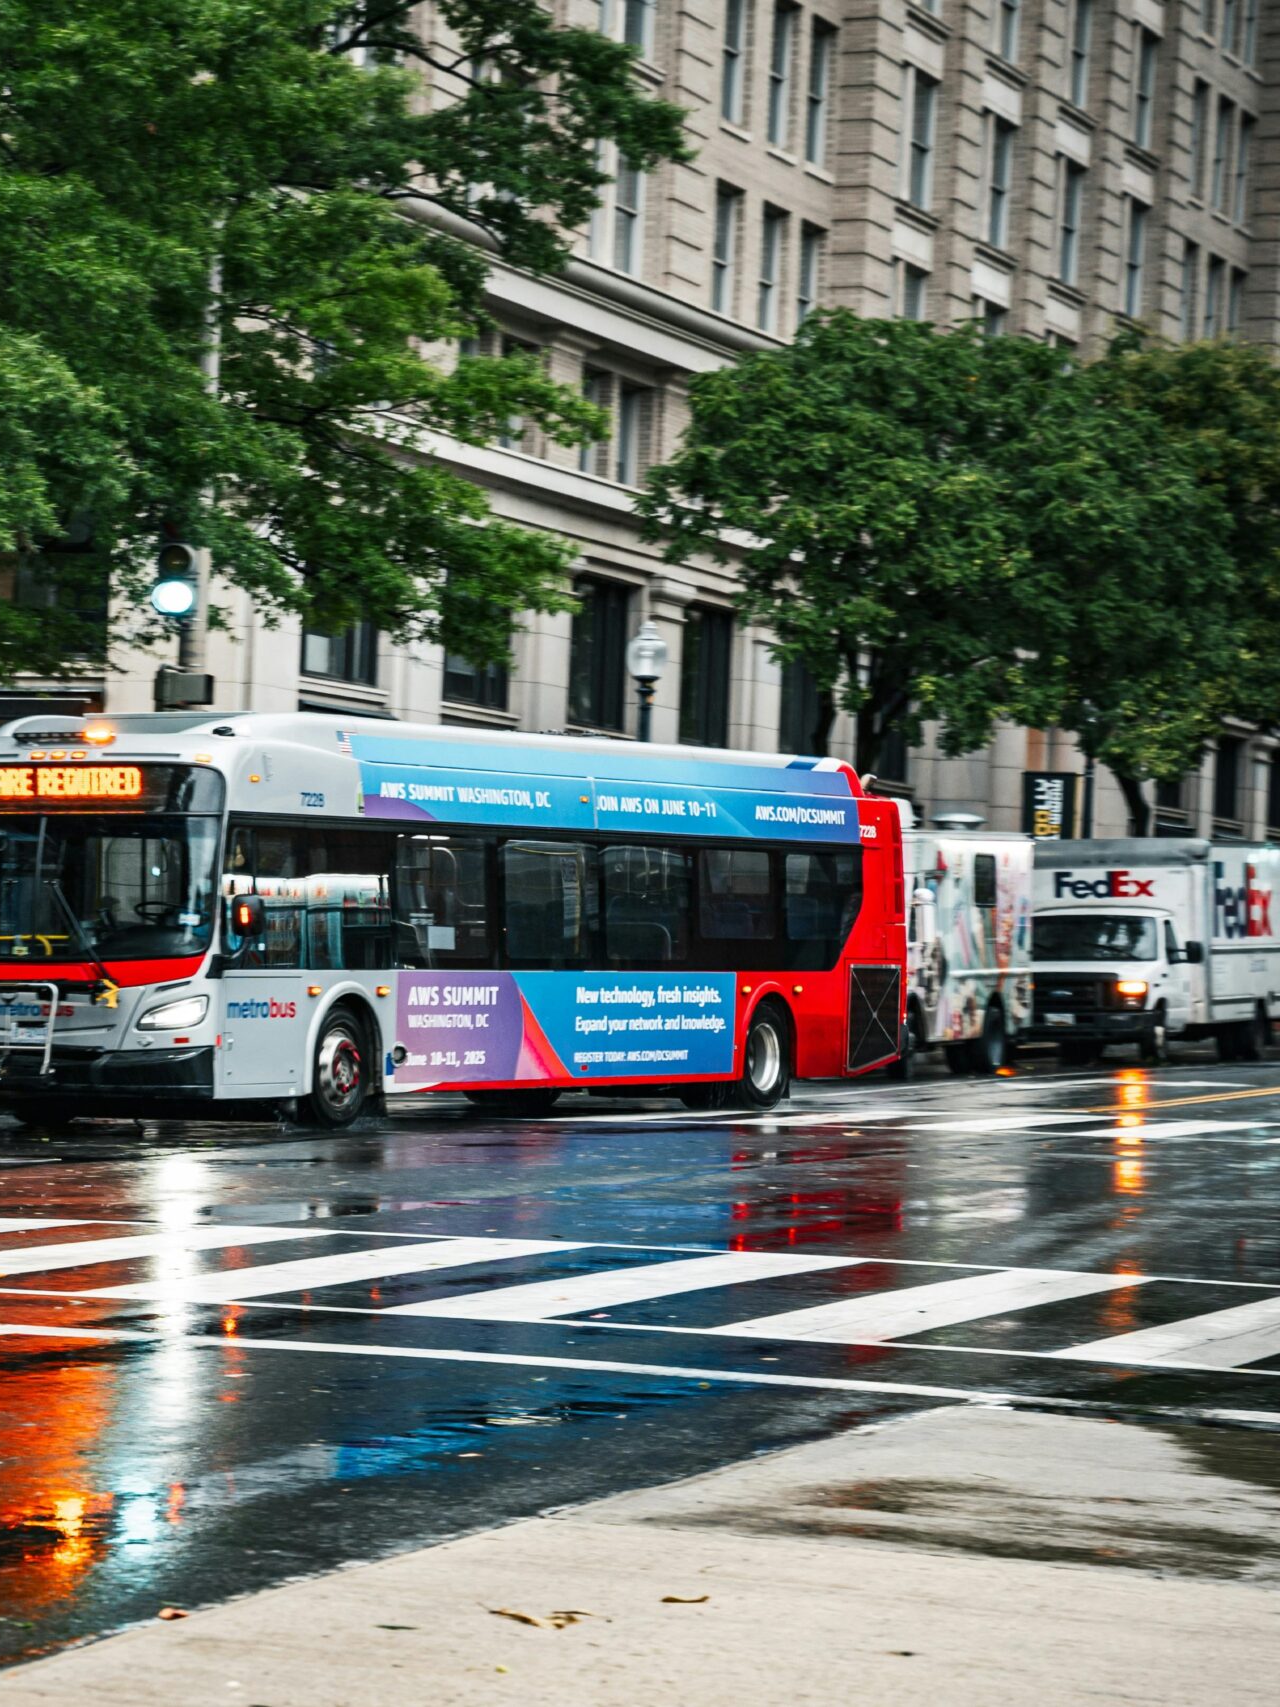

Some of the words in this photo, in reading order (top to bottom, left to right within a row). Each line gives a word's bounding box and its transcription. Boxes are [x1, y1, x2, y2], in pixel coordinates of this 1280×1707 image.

[36, 767, 142, 796] REQUIRED
[380, 782, 406, 799] AWS
[409, 783, 455, 802] SUMMIT
[456, 786, 534, 809] WASHINGTON,
[535, 791, 551, 808] DC
[596, 795, 618, 812] JOIN
[620, 797, 642, 813] AWS
[644, 798, 659, 814] ON
[661, 799, 686, 816] JUNE
[755, 805, 845, 825] AWS.COM/DCSUMMIT
[1054, 870, 1154, 899] FedEx
[408, 986, 439, 1006] AWS
[443, 986, 499, 1006] SUMMIT
[576, 986, 599, 1004] New
[600, 985, 656, 1007] technology,
[657, 985, 681, 1004] fresh
[683, 985, 722, 1007] insights.
[227, 996, 296, 1018] metrobus
[408, 1014, 474, 1030] WASHINGTON,
[475, 1013, 489, 1028] DC
[575, 1015, 607, 1035] Expand
[608, 1018, 628, 1035] your
[628, 1015, 663, 1031] network
[664, 1015, 680, 1030] and
[681, 1014, 726, 1033] knowledge.
[405, 1052, 427, 1066] June
[463, 1050, 486, 1065] 2025
[574, 1051, 603, 1063] REGISTER
[627, 1049, 688, 1063] AWS.COM/DCSUMMIT
